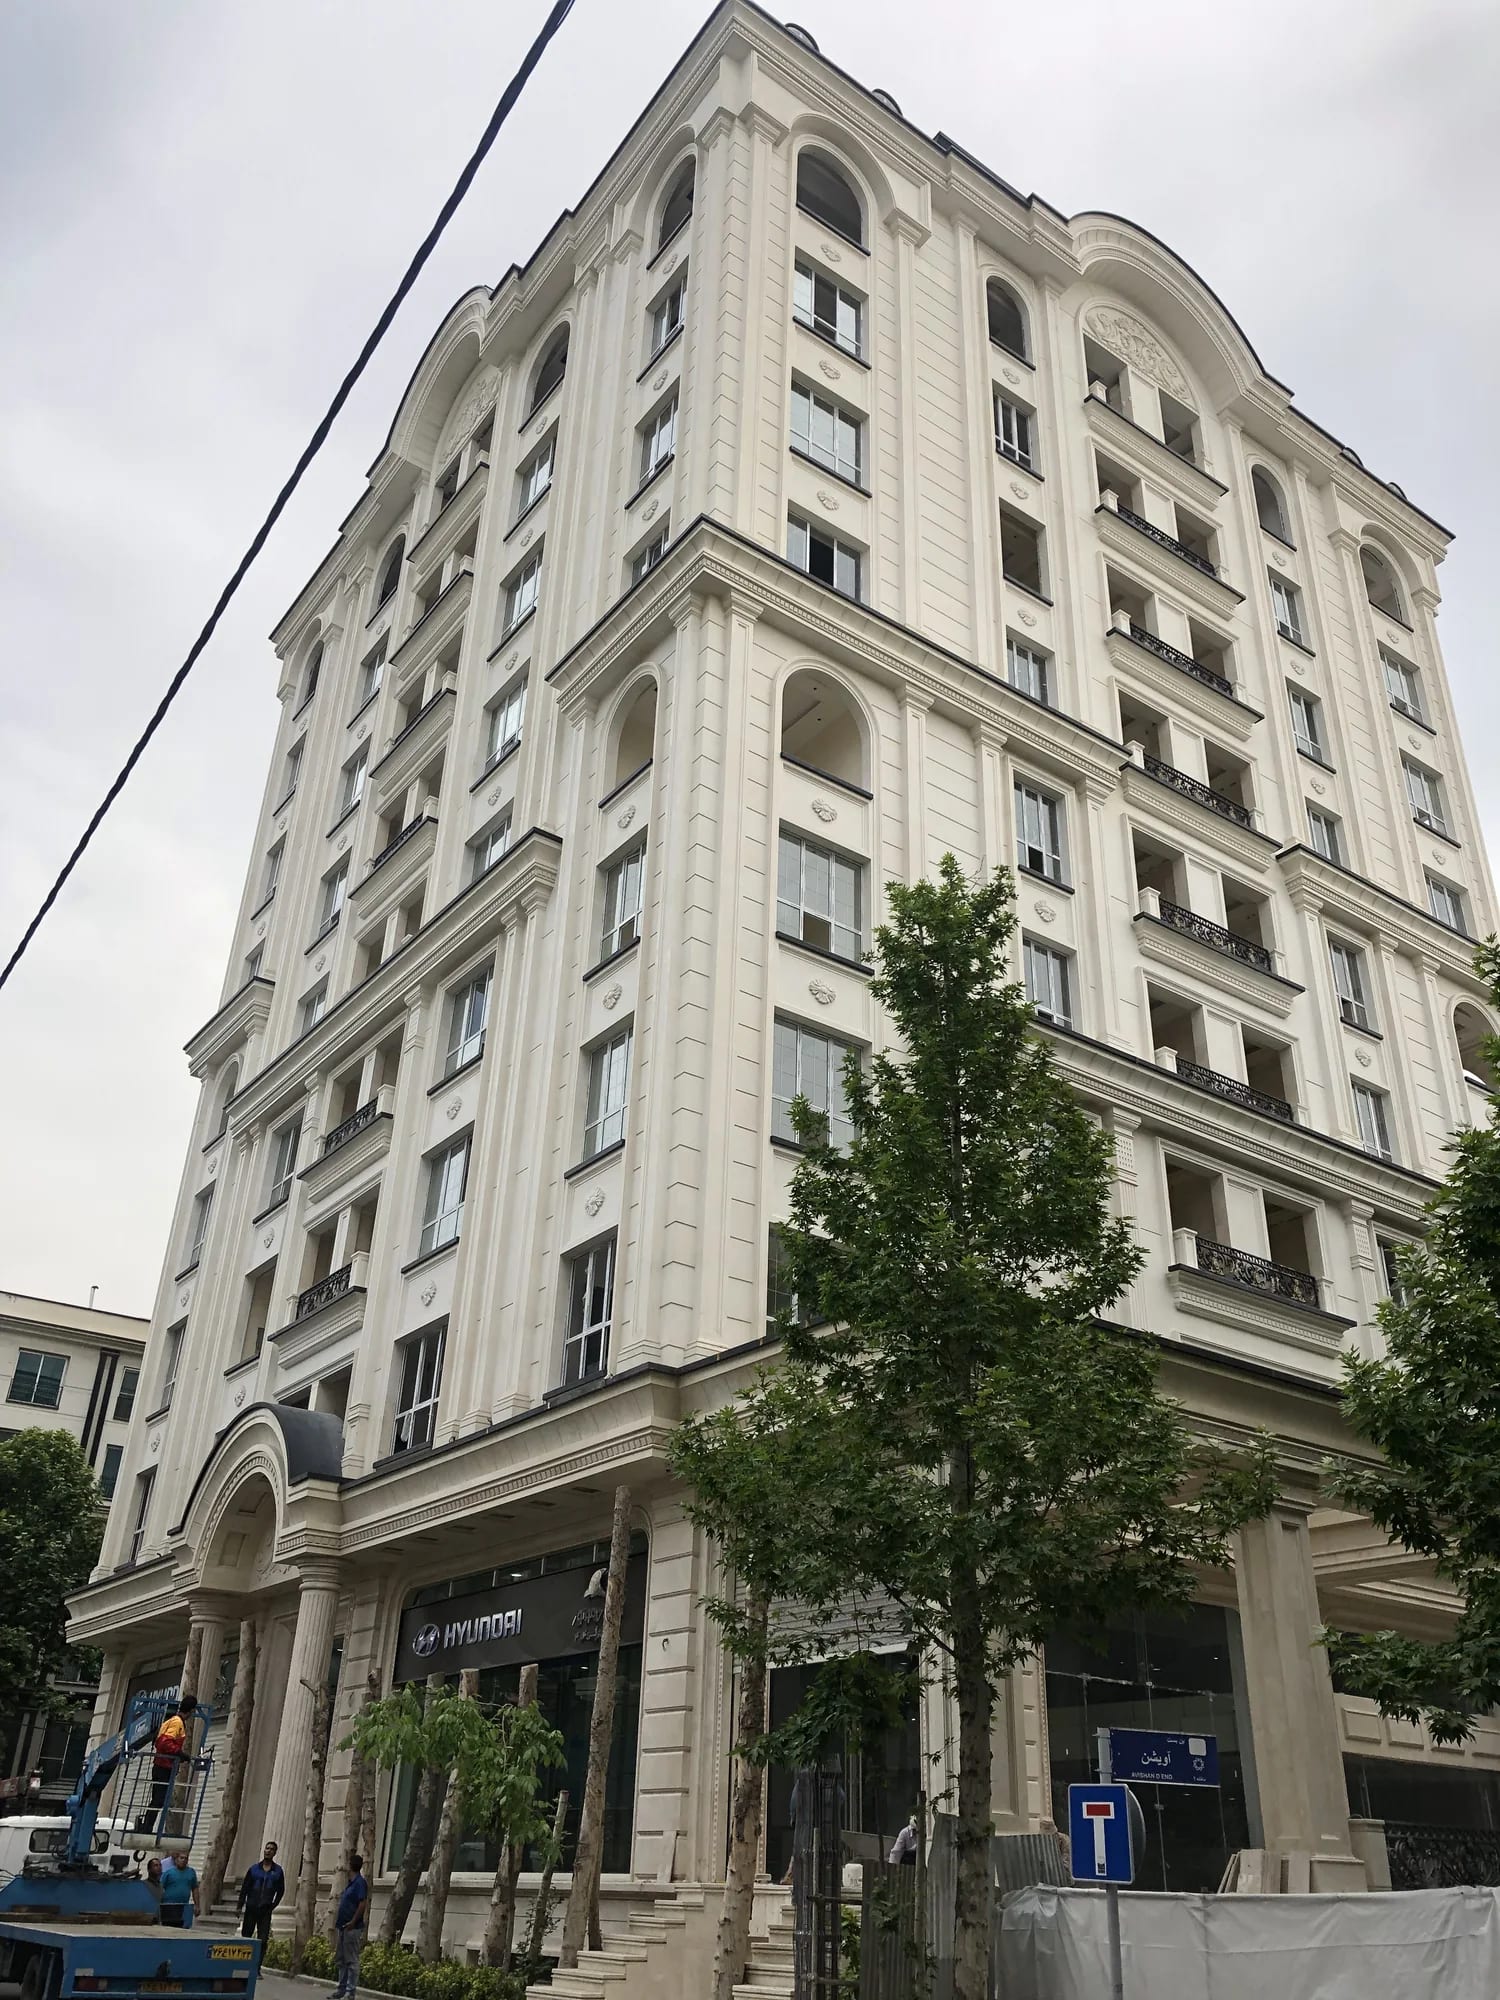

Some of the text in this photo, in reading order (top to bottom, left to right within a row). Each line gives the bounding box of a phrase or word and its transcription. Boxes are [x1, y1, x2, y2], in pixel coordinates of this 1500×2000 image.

[443, 1608, 522, 1648] HYUNDAI
[1141, 1750, 1171, 1767] آویشن
[1131, 1771, 1155, 1779] AVISHAN
